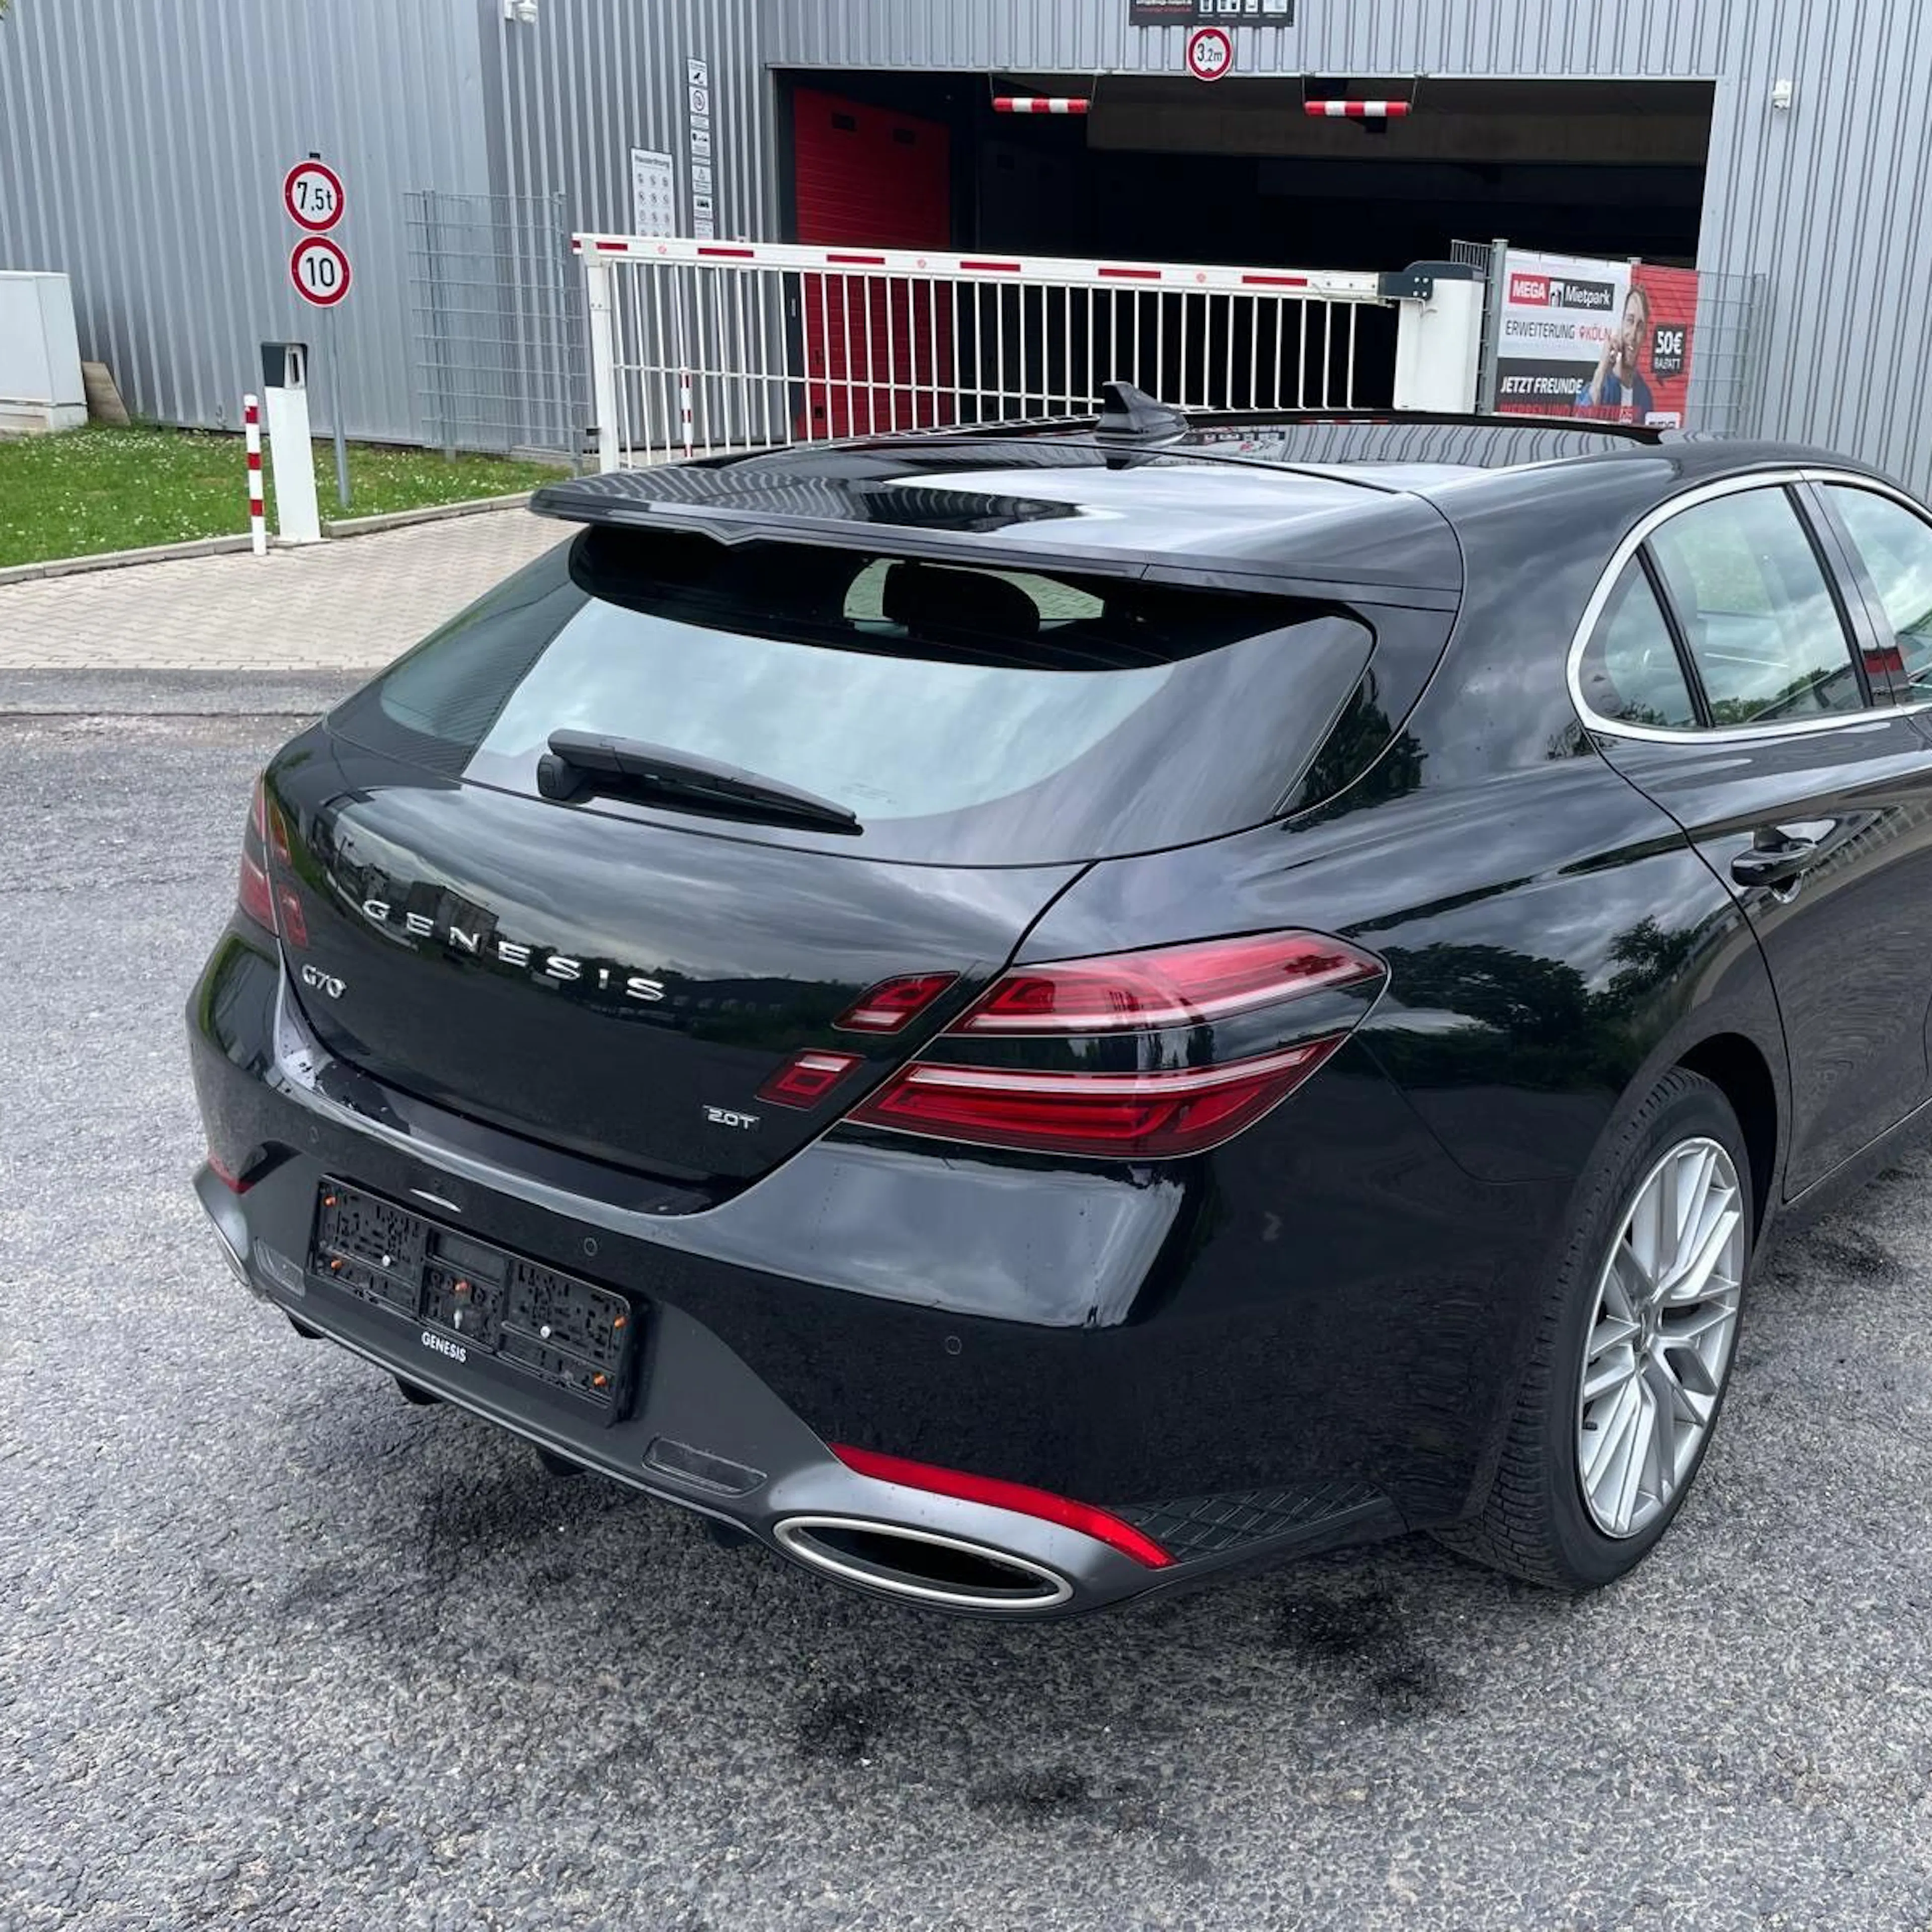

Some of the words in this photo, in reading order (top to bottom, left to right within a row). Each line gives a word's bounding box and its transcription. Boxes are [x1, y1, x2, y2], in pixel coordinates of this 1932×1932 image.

[306, 257, 335, 287] 10
[1512, 280, 1546, 300] MEGA
[1565, 285, 1611, 307] Mietpark
[1505, 320, 1575, 339] ERWEITERUNG
[1654, 331, 1683, 355] 50€
[1500, 376, 1534, 394] JETZT
[1534, 377, 1584, 395] FREUNDE
[362, 899, 666, 1001] GENESIS
[302, 964, 347, 999] G70
[422, 1331, 466, 1363] GENESIS
